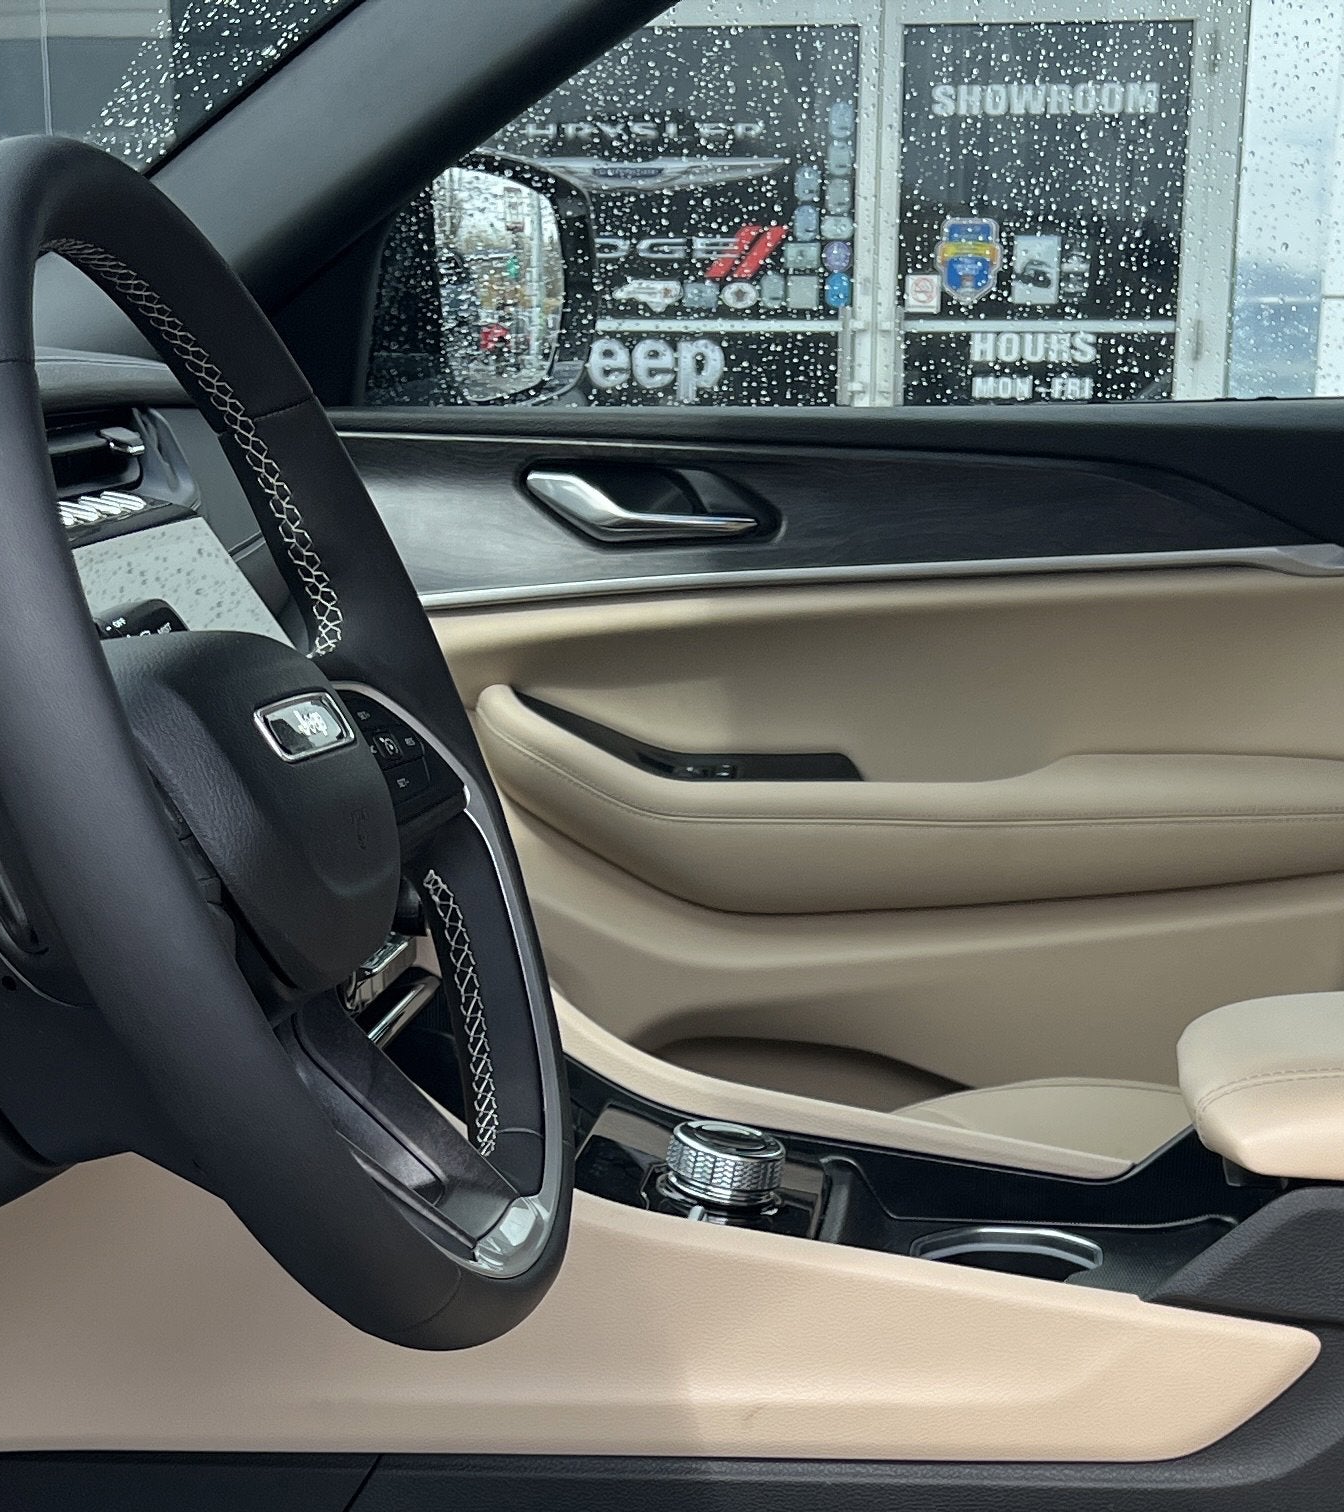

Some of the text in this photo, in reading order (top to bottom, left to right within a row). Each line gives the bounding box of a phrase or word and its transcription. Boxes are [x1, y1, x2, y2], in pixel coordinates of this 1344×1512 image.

[931, 82, 1160, 116] SHOWROOM
[522, 121, 765, 143] HRYSLER
[970, 332, 1098, 363] HOURS
[587, 338, 726, 401] eep
